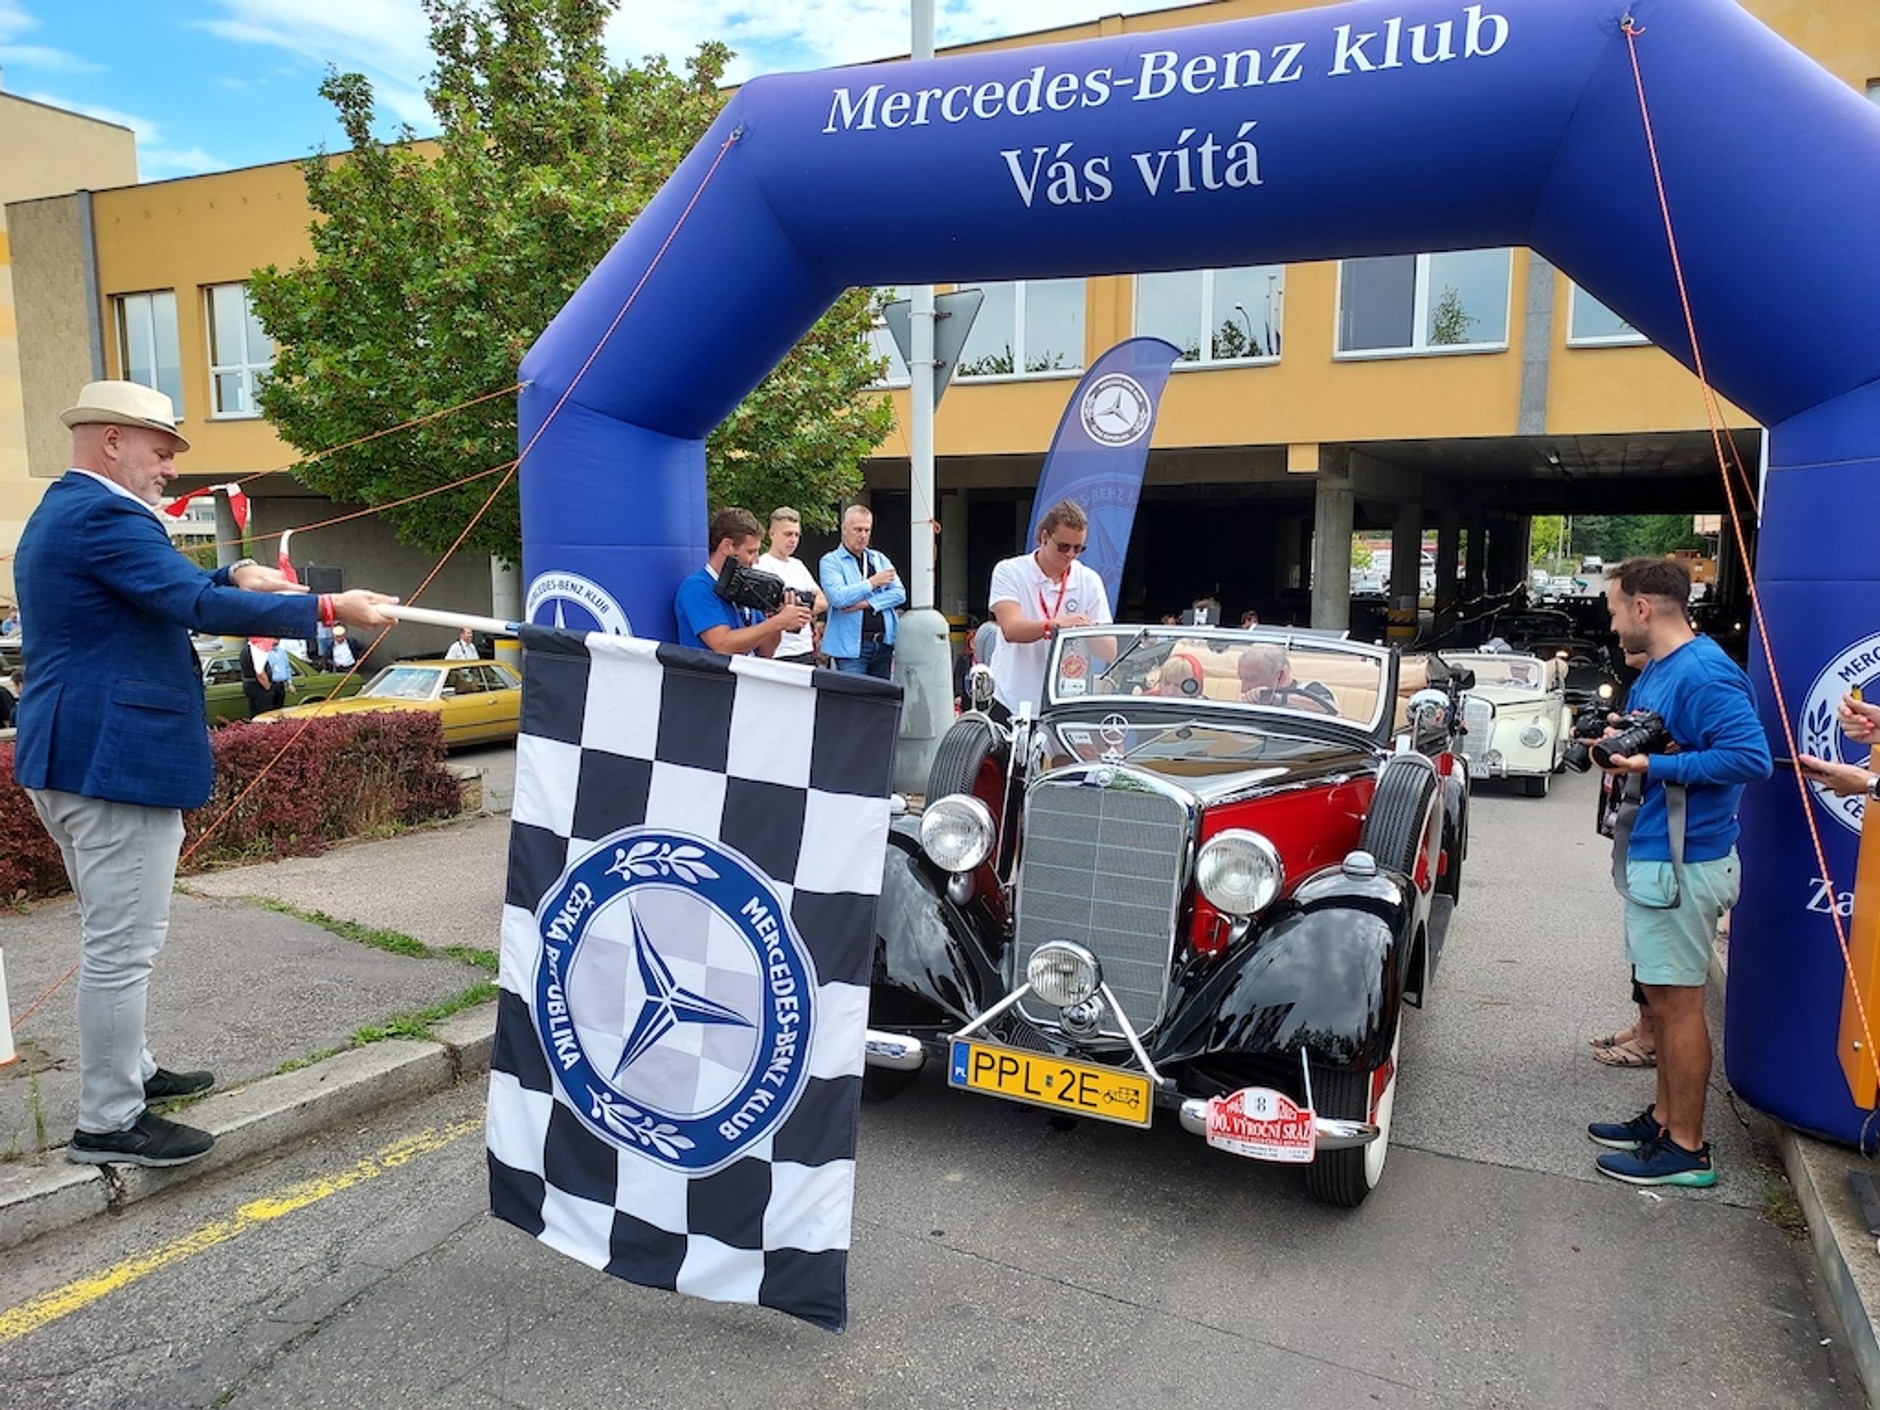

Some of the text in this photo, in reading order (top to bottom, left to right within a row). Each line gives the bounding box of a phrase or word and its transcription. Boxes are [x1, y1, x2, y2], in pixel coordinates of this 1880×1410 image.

[822, 4, 1510, 133] Mercedes-Benz klub
[1000, 121, 1264, 208] Vás vítá
[717, 895, 801, 1142] MERCEDES-BENZ KLUB
[974, 1050, 1100, 1108] PPL 2E
[1256, 1096, 1267, 1113] 8
